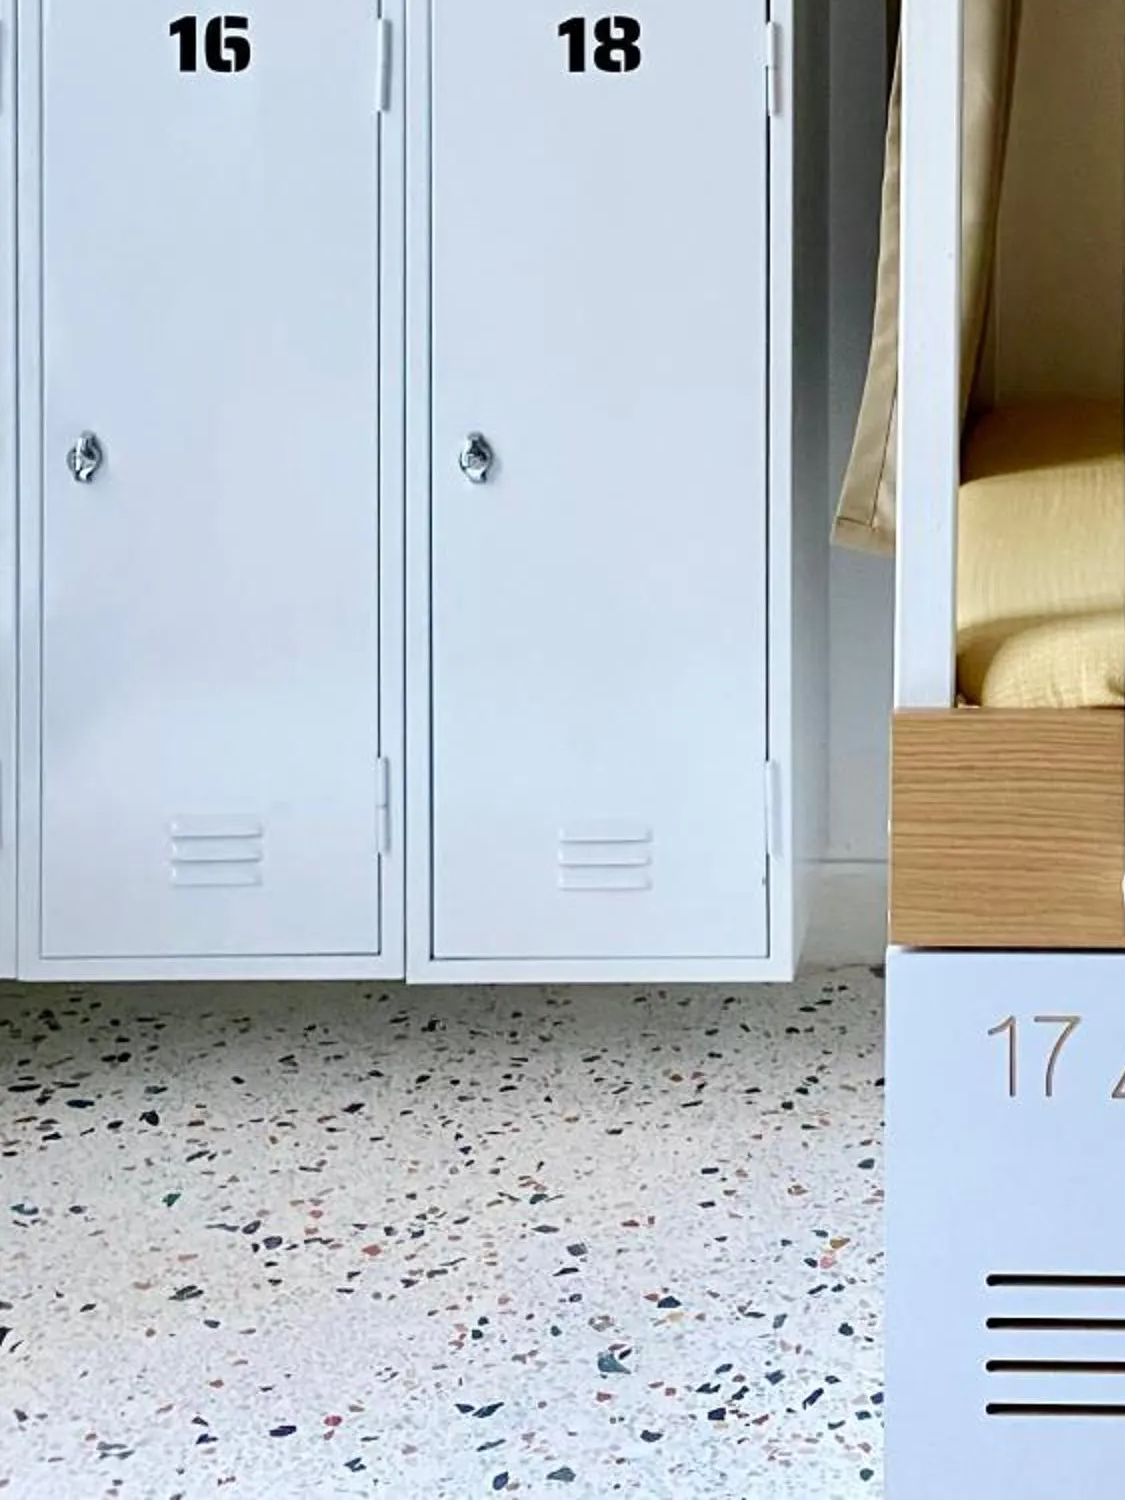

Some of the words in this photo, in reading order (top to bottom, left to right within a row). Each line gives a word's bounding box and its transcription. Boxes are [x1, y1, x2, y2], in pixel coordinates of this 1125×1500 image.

[168, 15, 251, 73] 16
[557, 15, 641, 73] 18
[987, 1014, 1082, 1098] 17
